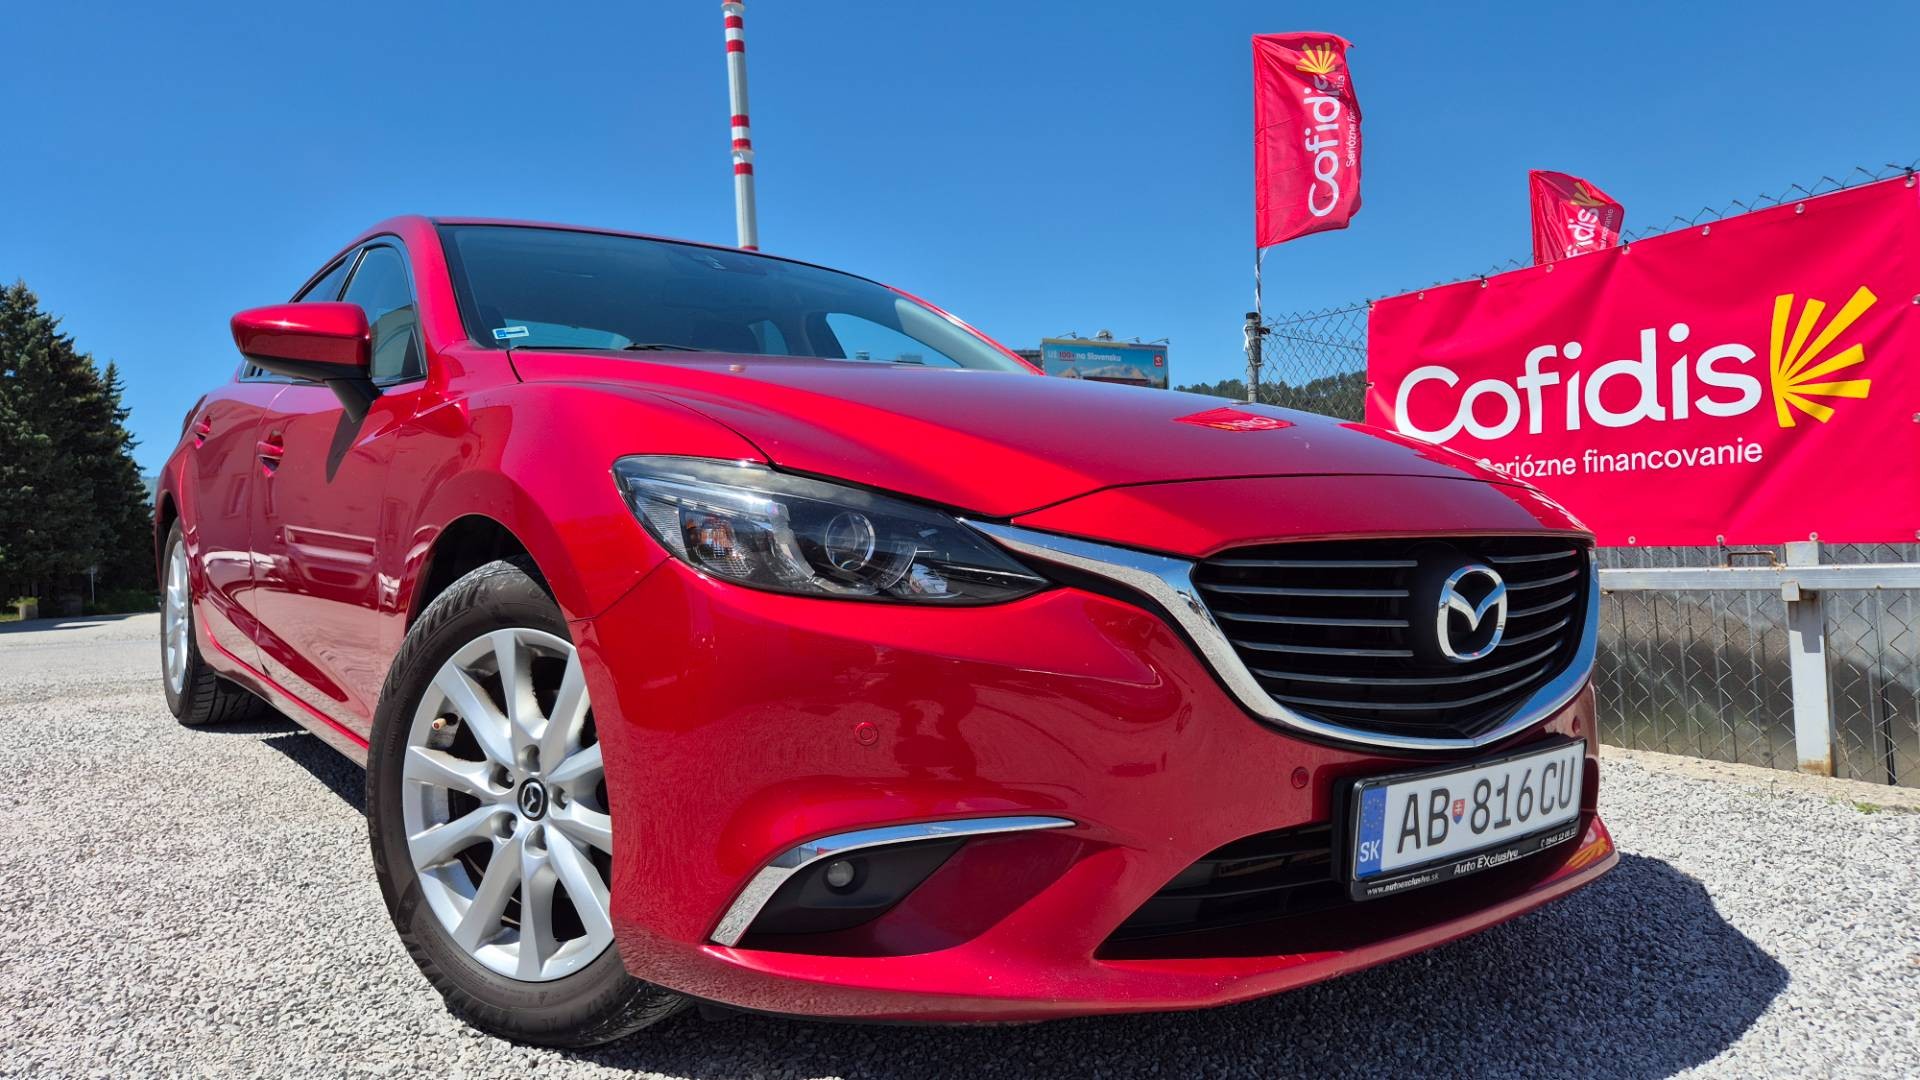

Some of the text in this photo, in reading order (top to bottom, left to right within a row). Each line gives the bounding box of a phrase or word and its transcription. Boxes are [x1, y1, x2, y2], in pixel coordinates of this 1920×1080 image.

[1566, 207, 1599, 258] fidis
[1395, 323, 1763, 445] Cofidis
[1583, 437, 1763, 473] financovanie
[1397, 787, 1450, 854] AB
[1359, 839, 1382, 863] SK
[1453, 861, 1476, 875] Auto
